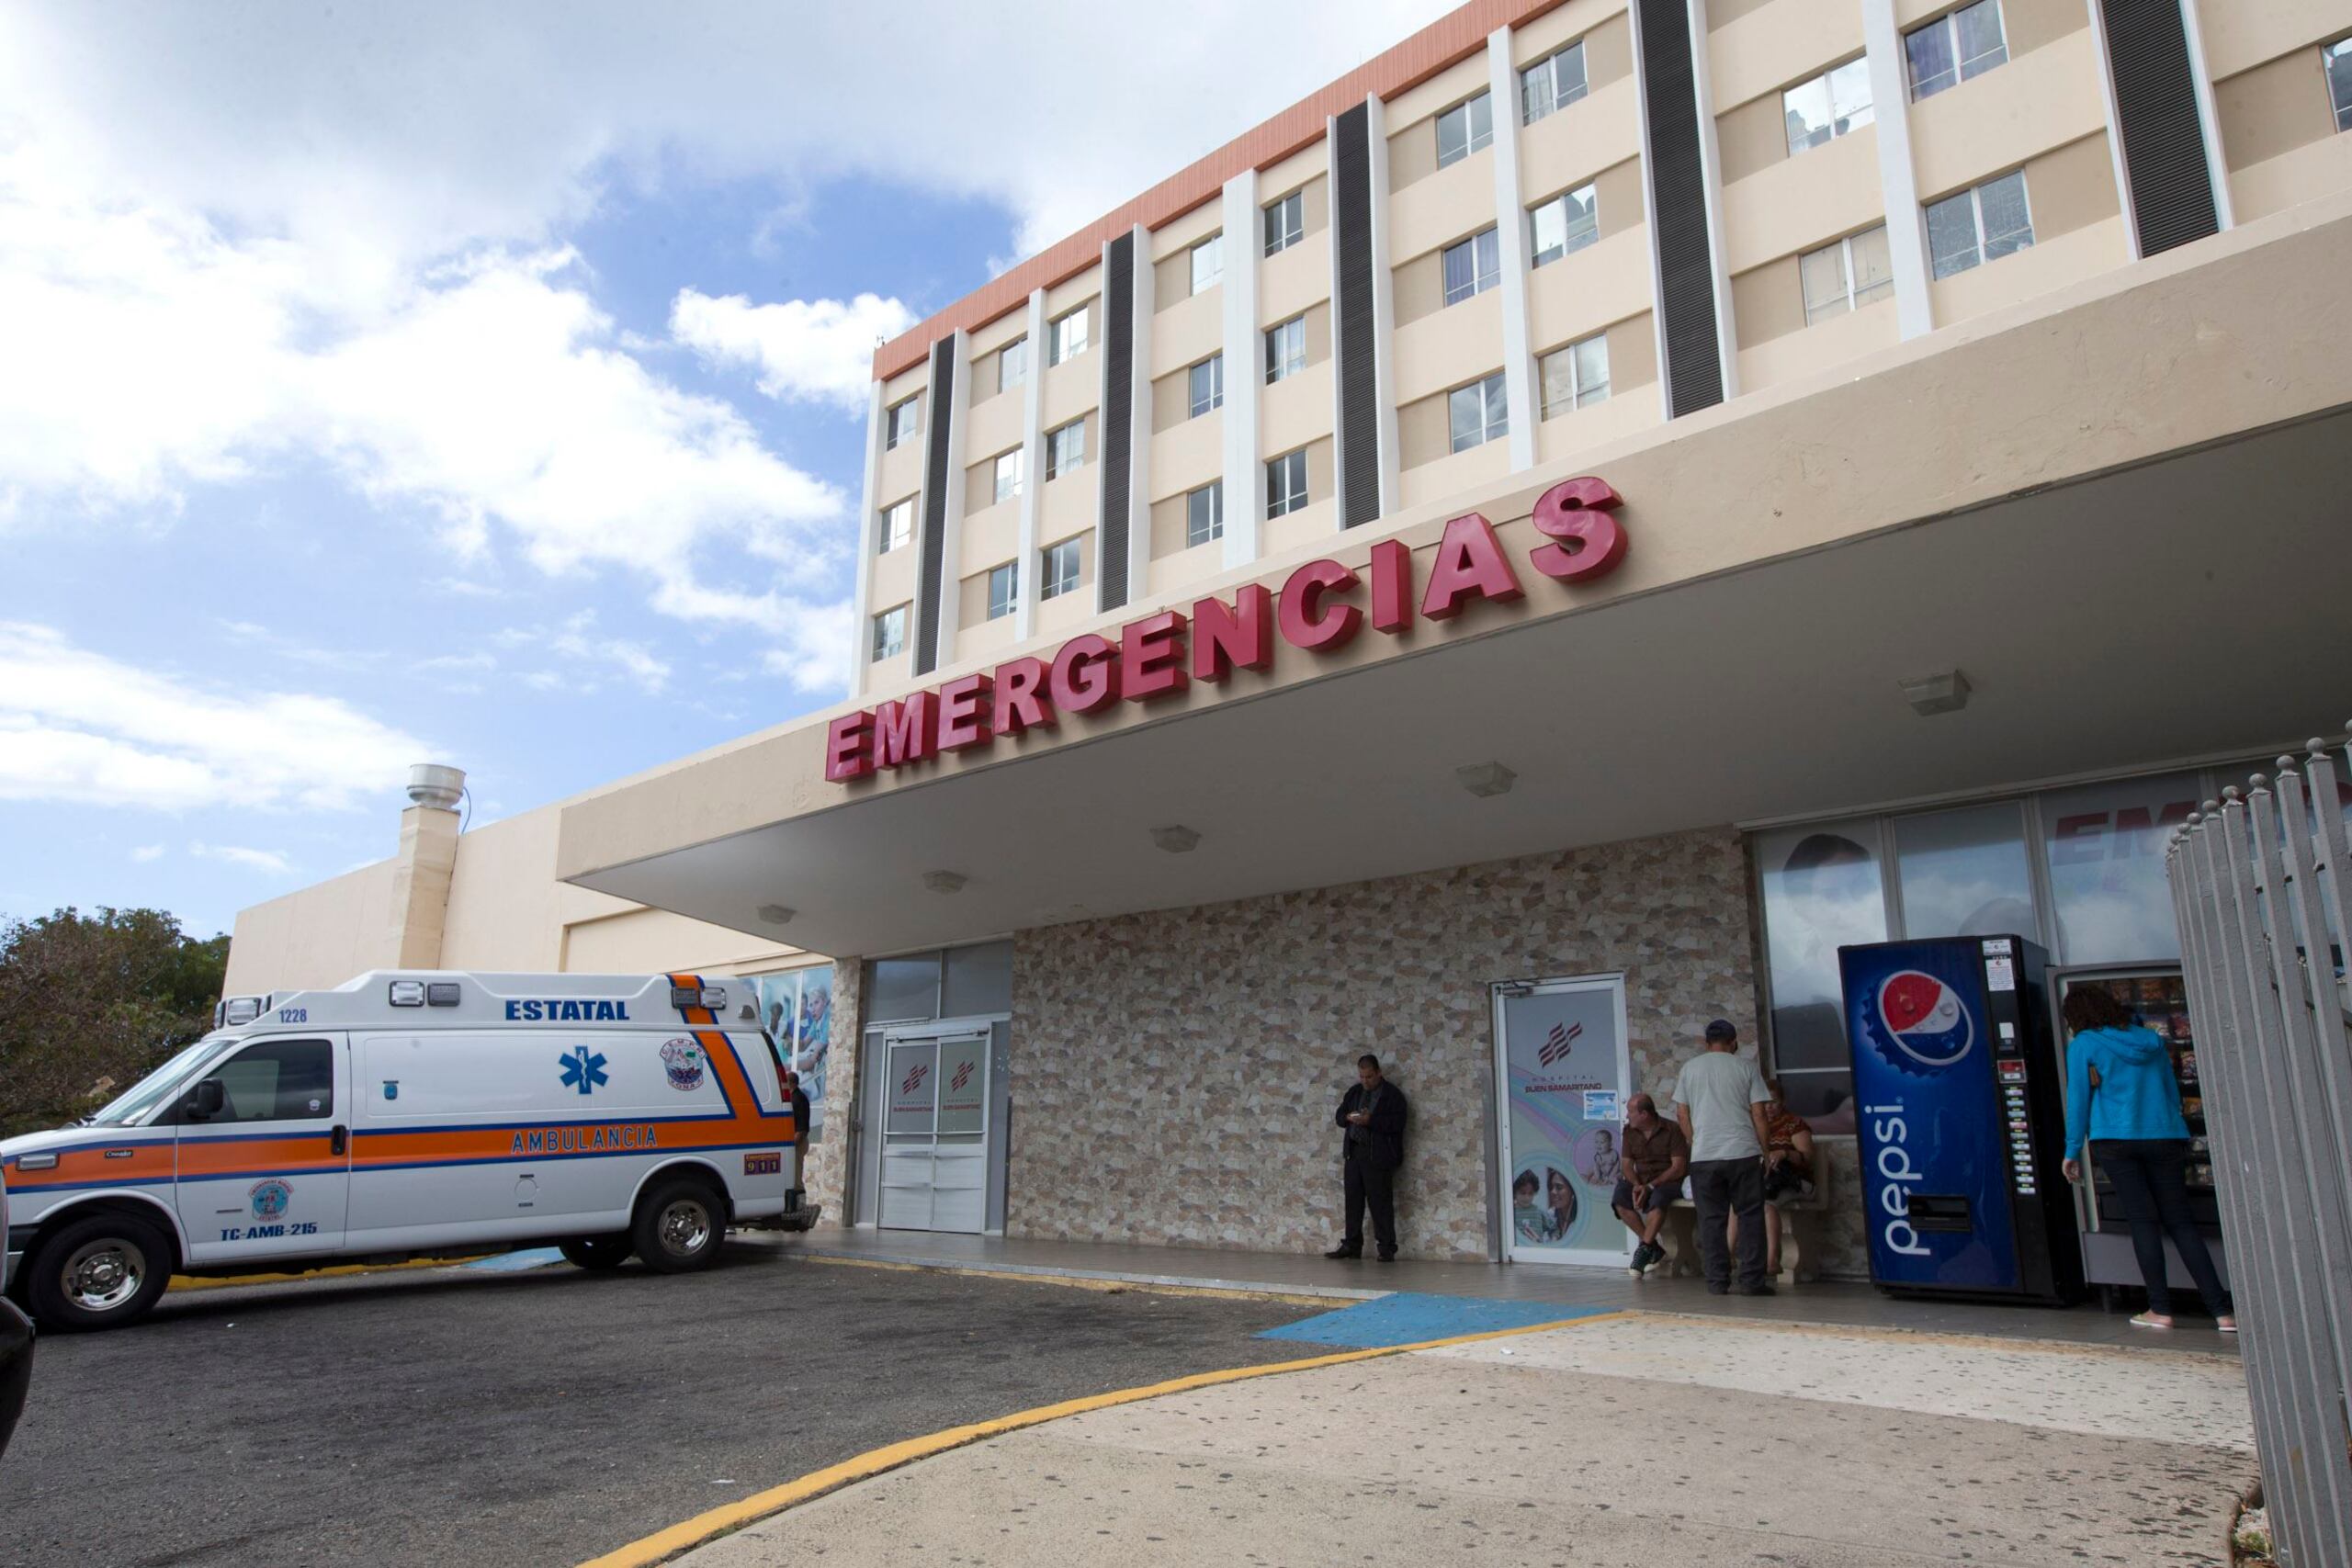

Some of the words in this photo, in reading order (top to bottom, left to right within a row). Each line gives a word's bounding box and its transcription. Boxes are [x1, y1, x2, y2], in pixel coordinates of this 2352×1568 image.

[825, 476, 1629, 784] EMERGENCIAS
[278, 1008, 308, 1023] 1228
[505, 999, 630, 1021] ESTATAL
[511, 1125, 658, 1154] AMBULANCIA
[747, 1160, 777, 1171] 911
[1864, 1105, 1931, 1256] pepsi
[220, 1222, 318, 1241] TC-AMB-215
